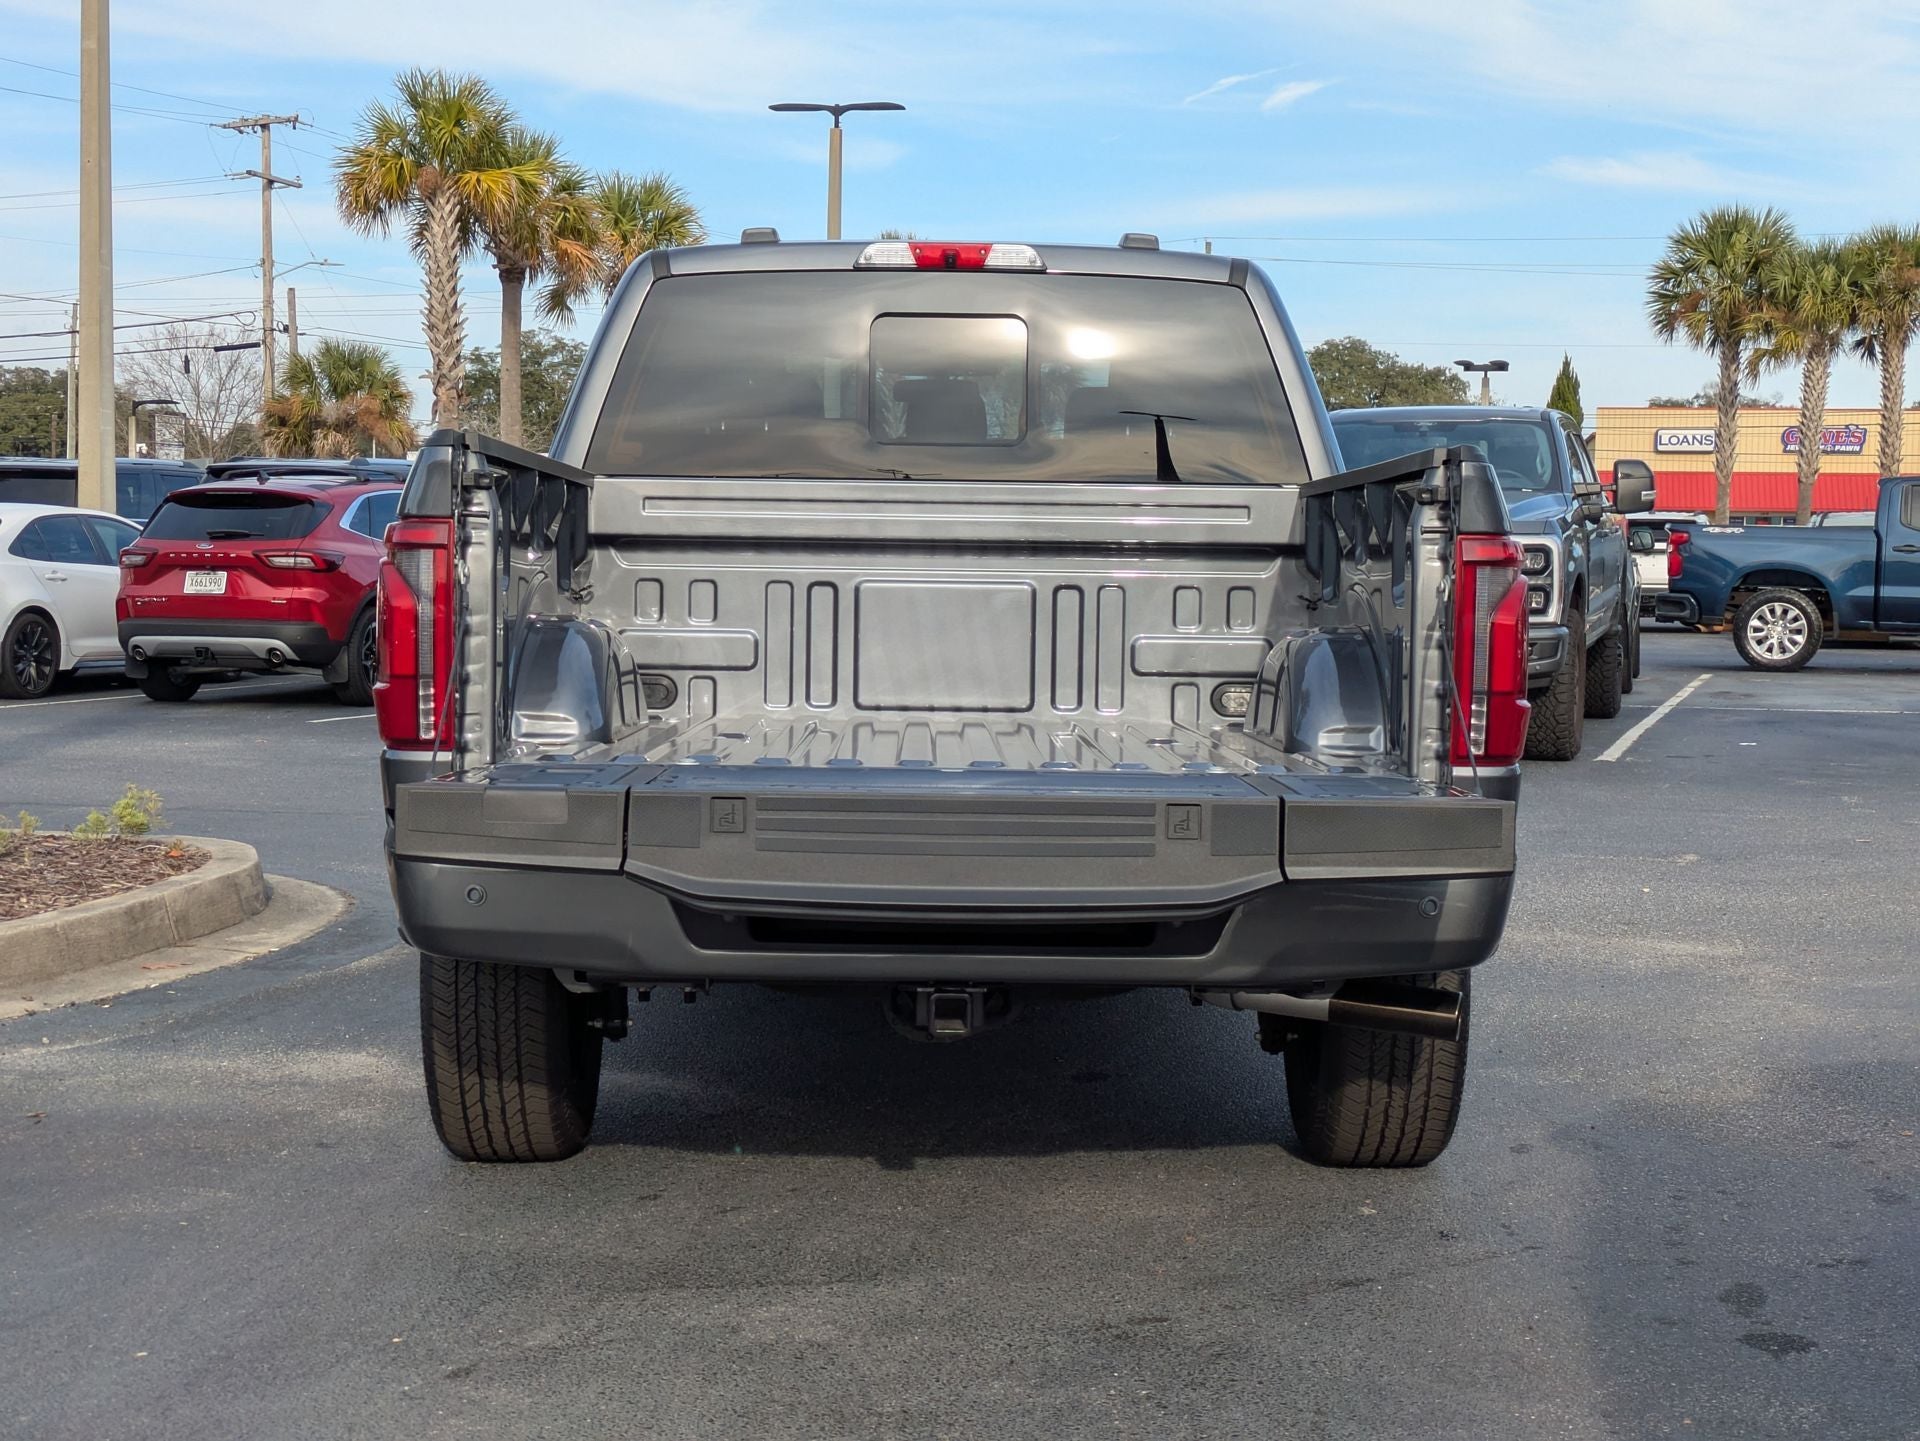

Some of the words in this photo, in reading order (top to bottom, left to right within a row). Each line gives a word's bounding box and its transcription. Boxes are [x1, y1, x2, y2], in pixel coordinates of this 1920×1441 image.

[1659, 434, 1714, 446] LOANS
[1784, 427, 1864, 444] GNE'S
[190, 577, 222, 588] X661990
